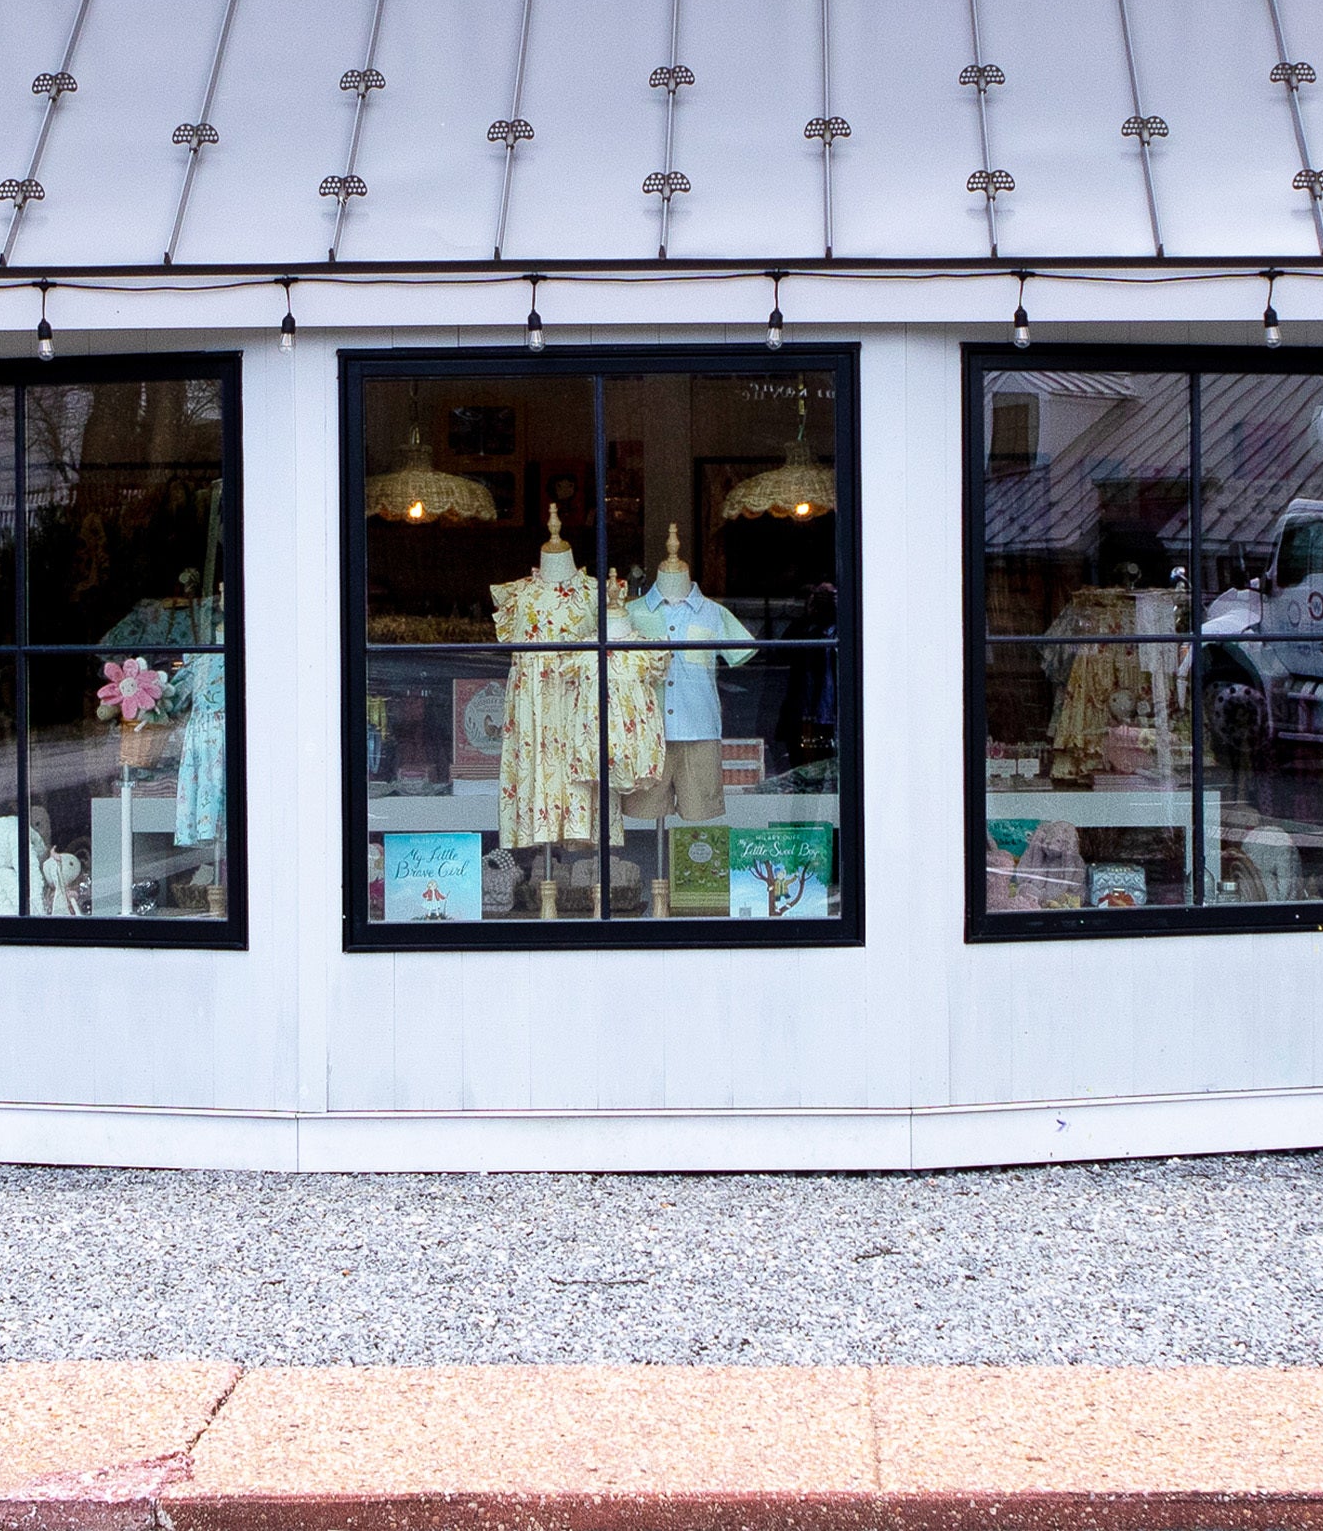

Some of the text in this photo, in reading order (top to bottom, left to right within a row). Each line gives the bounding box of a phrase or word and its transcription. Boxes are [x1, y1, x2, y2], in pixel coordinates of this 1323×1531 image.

[403, 845, 458, 868] My Little
[741, 842, 767, 858] Little
[797, 842, 820, 859] Boy
[394, 860, 470, 879] Brave Girl
